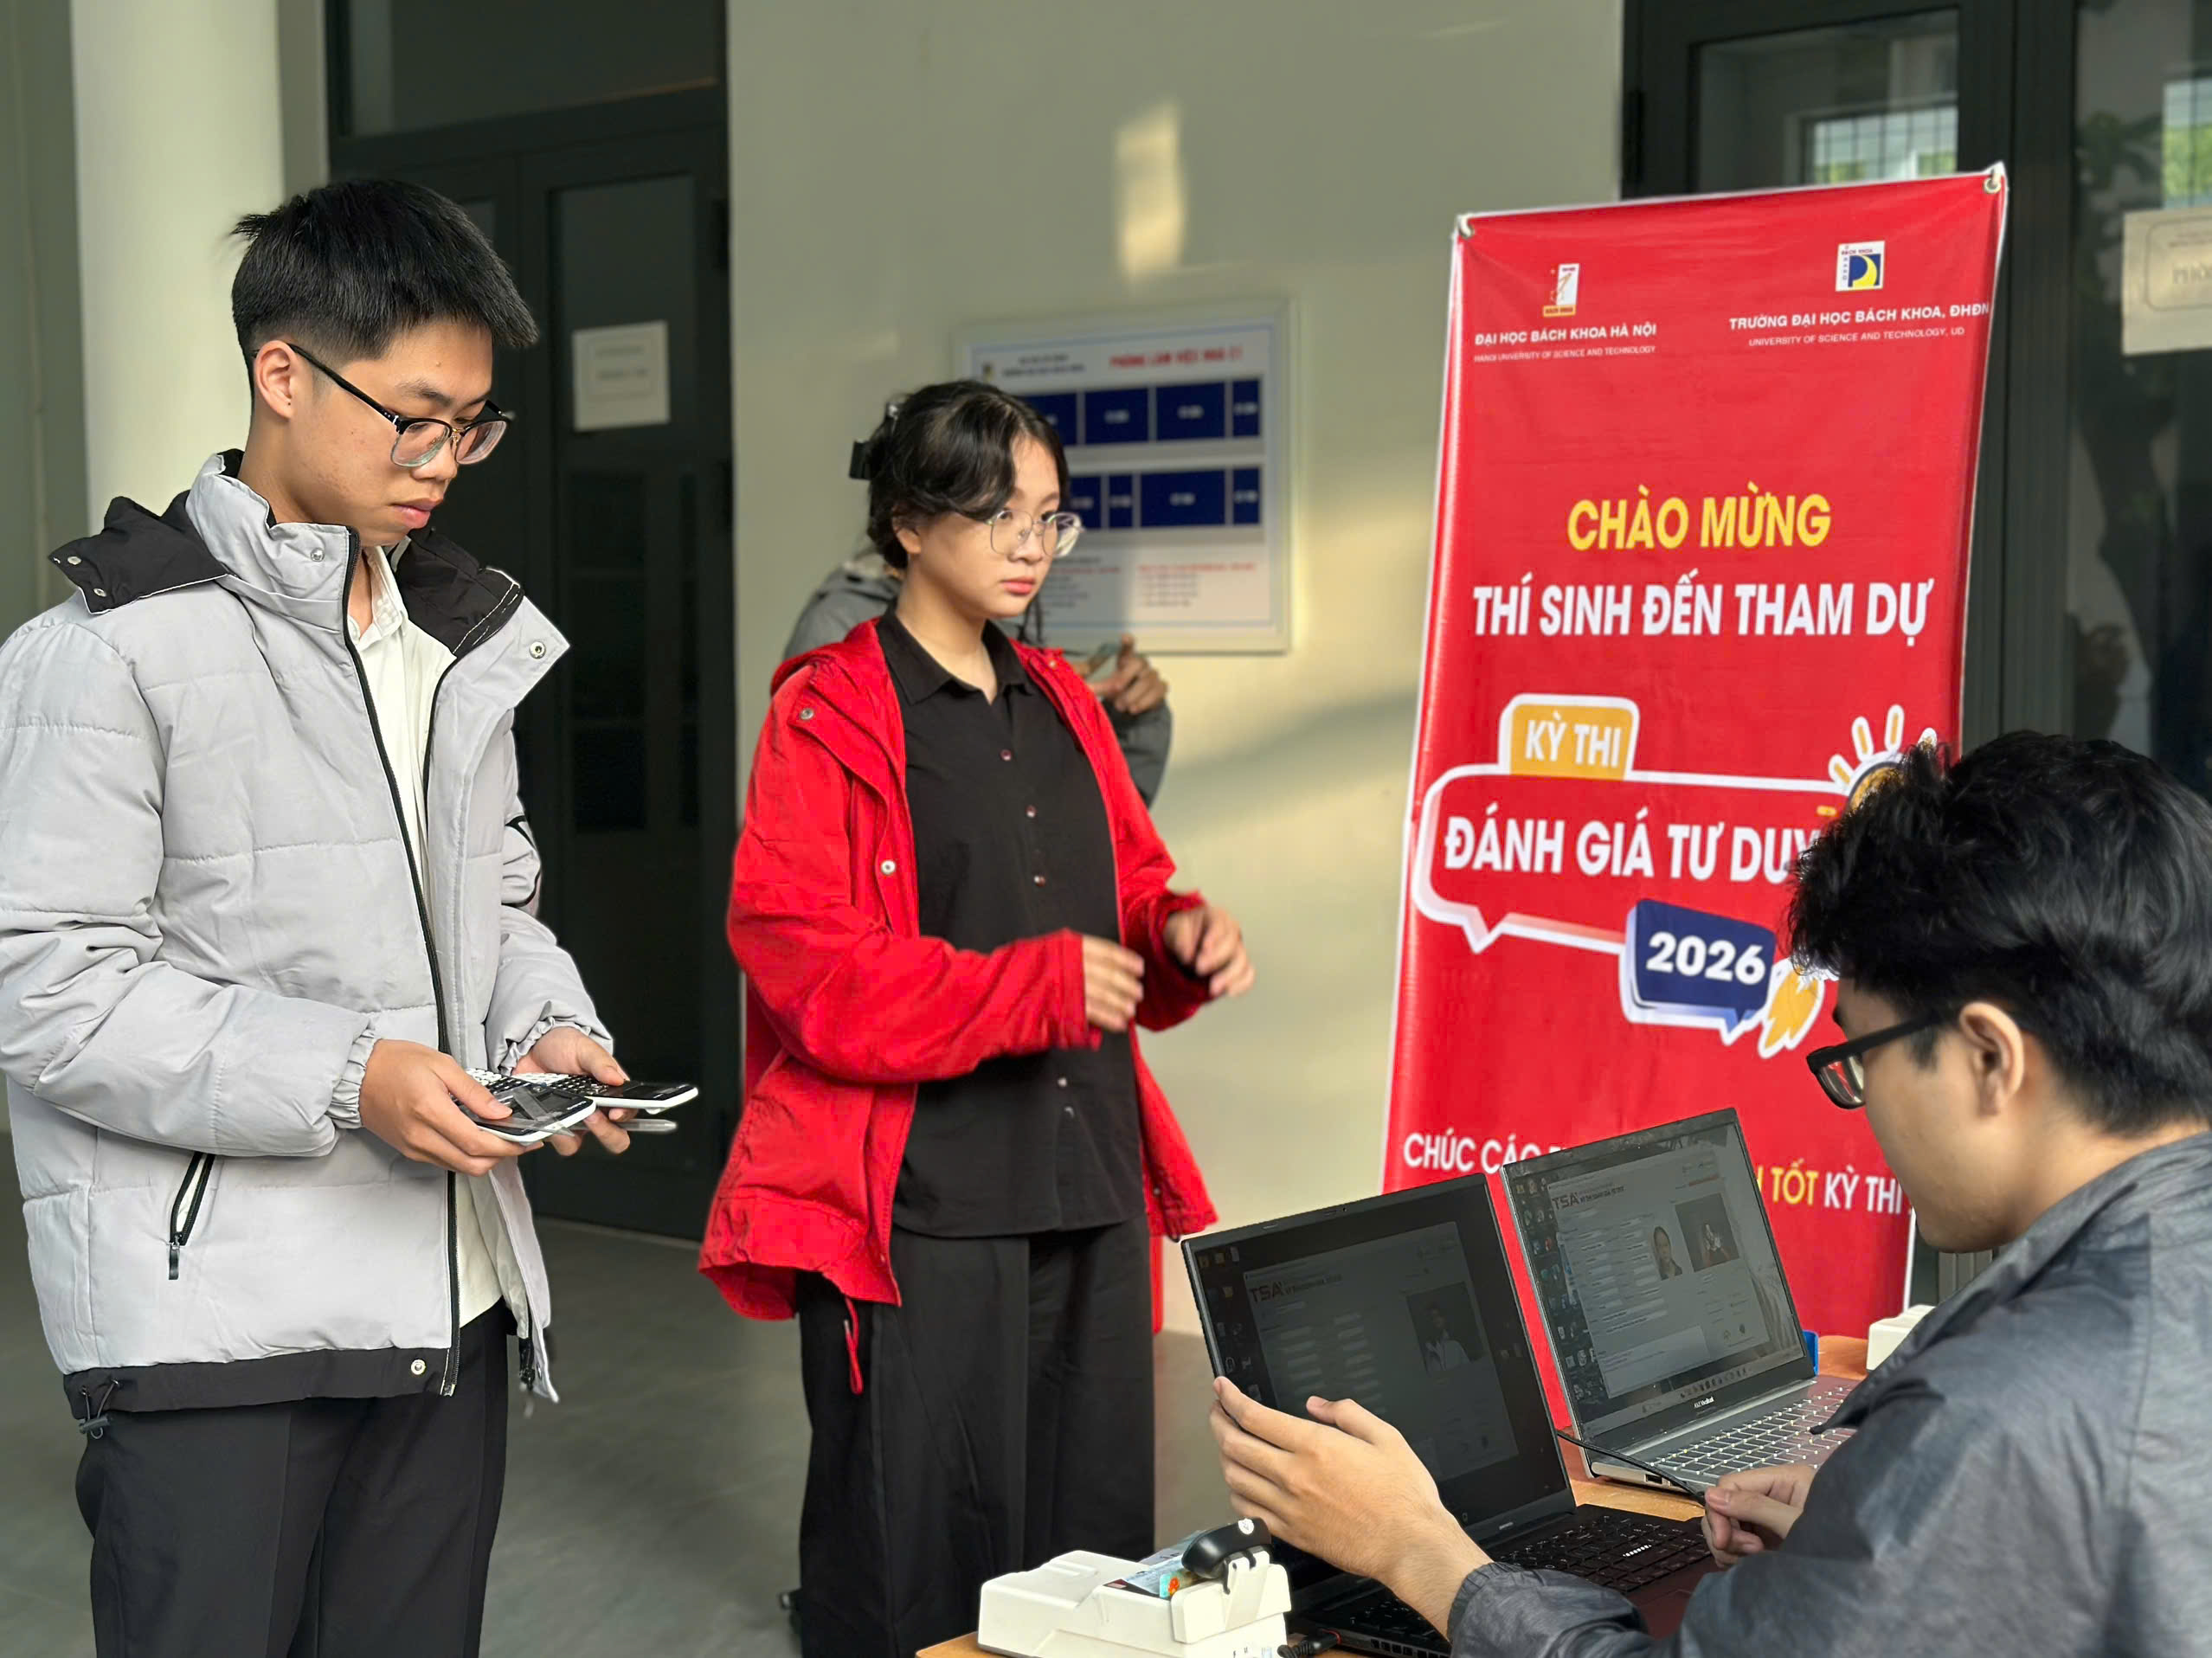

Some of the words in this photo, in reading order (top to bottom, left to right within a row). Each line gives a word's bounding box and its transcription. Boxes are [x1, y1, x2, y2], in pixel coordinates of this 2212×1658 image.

[1475, 333, 1496, 346] ĐẠI
[1500, 331, 1527, 345] HỌC
[1531, 328, 1567, 343] BÁCH
[1570, 326, 1607, 339] KHOA
[1610, 322, 1629, 338] HÀ
[1632, 320, 1656, 337] NỘI
[1729, 313, 1788, 330] TRƯỜNG
[1791, 312, 1816, 328] ĐẠI
[1819, 312, 1851, 325] HỌC
[1855, 307, 1897, 323] BÁCH
[1748, 336, 1801, 346] UNIVERSITY
[1804, 334, 1816, 344] OF
[1818, 332, 1858, 343] SCIENCE
[1861, 331, 1881, 341] AND
[1951, 326, 1965, 336] UD
[1474, 353, 1496, 363] HANOI
[1498, 350, 1540, 362] UNIVERSITY
[1542, 350, 1553, 359] OF
[1553, 348, 1585, 359] SCIENCE
[1586, 347, 1604, 357] AND
[1604, 345, 1656, 356] TECHNOLOGY
[1566, 484, 1690, 550] CHÀO
[1700, 481, 1832, 549] MỪNG
[1473, 571, 1534, 637] THÍ
[1539, 583, 1634, 638] SINH
[1641, 568, 1725, 637] ĐẾN
[1734, 582, 1855, 637] THAM
[1865, 577, 1936, 647] DỰ
[1524, 711, 1568, 763] KỲ
[1572, 723, 1624, 768] THI
[1444, 802, 1566, 874] ĐÁNH
[1576, 807, 1656, 878] GIÁ
[1667, 821, 1726, 882] TƯ
[1645, 930, 1767, 986] 2026
[1403, 1128, 1476, 1173] CHÚC
[1771, 1158, 1820, 1205] TỐT
[1823, 1165, 1861, 1210] KỲ
